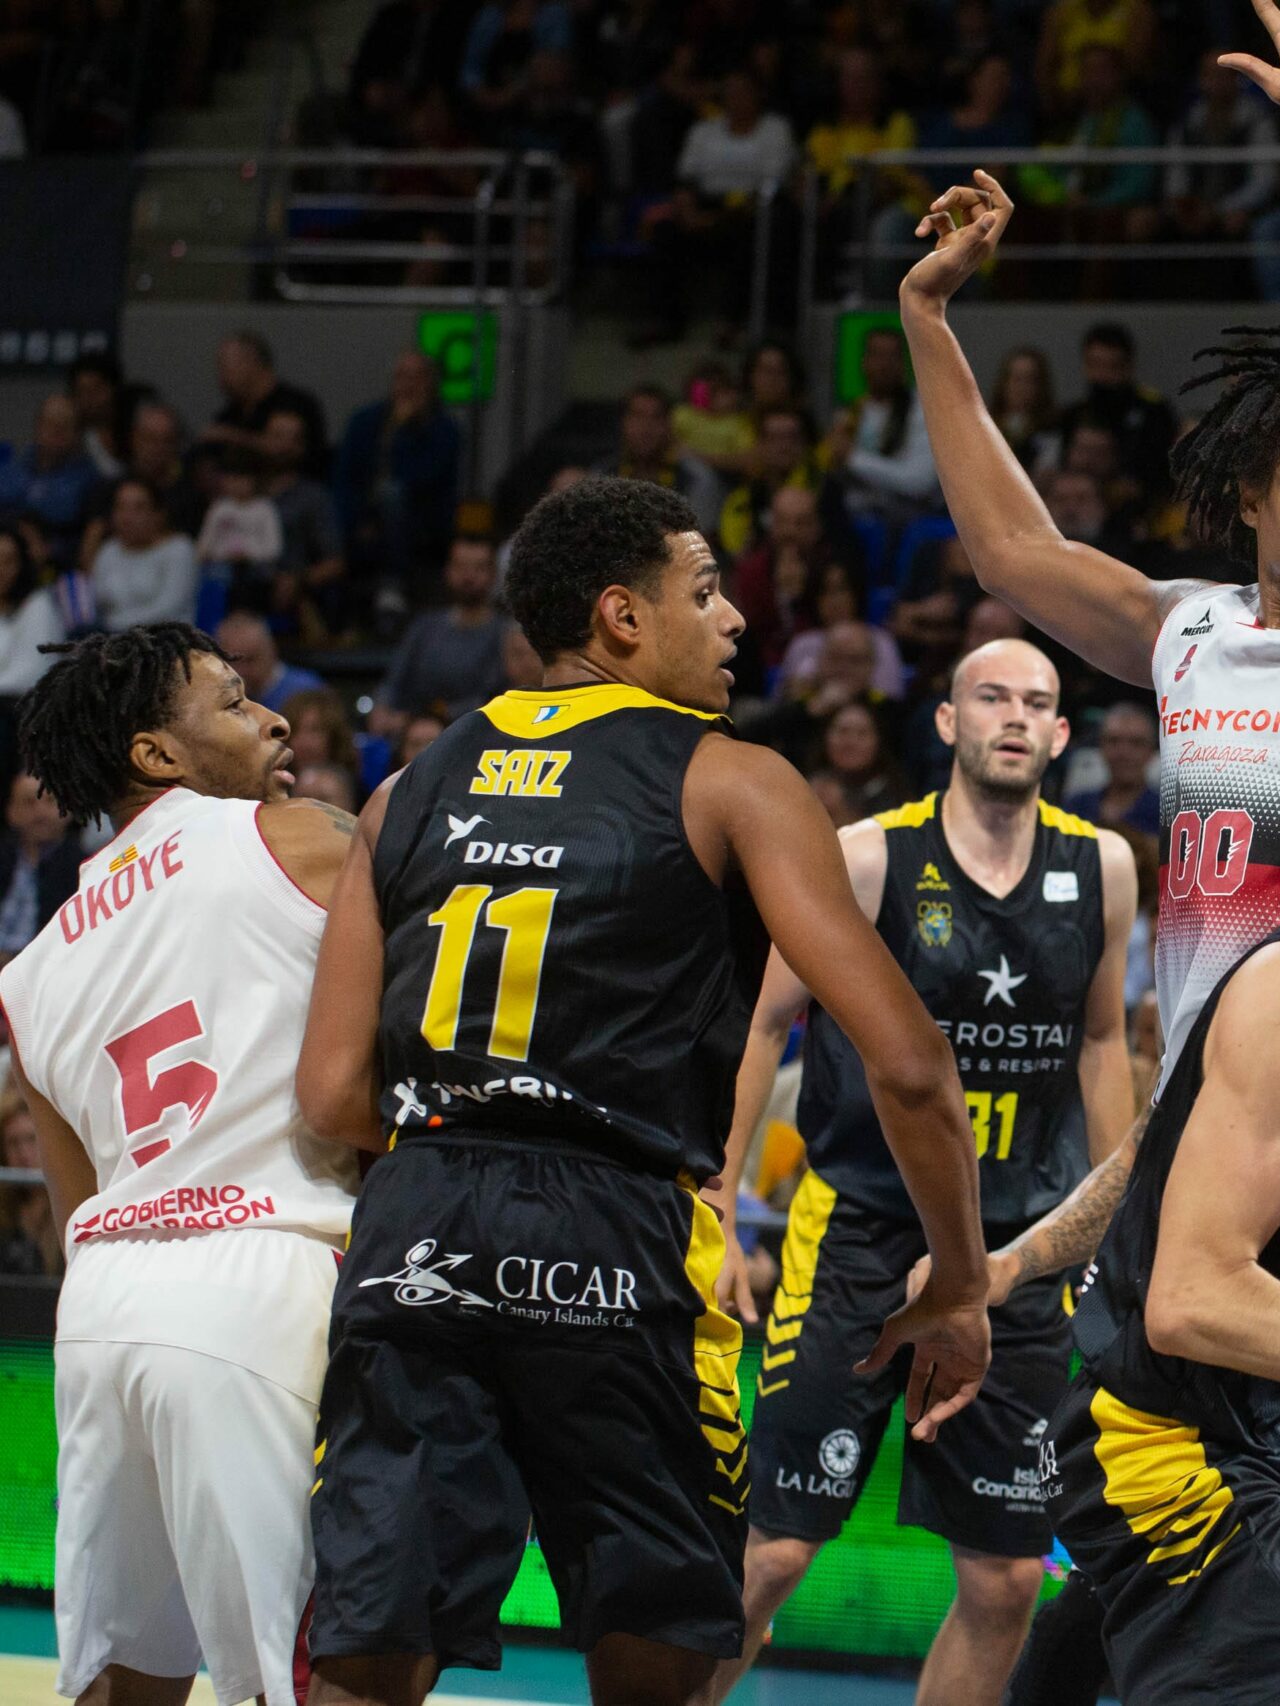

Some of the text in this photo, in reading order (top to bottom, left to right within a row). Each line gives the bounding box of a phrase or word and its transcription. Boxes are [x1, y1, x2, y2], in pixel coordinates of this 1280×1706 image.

[469, 749, 572, 798] SAIZ
[1178, 741, 1269, 772] Zaragoza
[1167, 808, 1255, 899] 00
[59, 829, 184, 944] OKOYE
[420, 883, 560, 1063] 11
[103, 997, 219, 1170] 5
[103, 1184, 245, 1233] GOBIERNO
[496, 1256, 640, 1311] CICAR
[496, 1301, 551, 1325] Canary
[554, 1307, 609, 1328] Islands
[776, 1467, 803, 1492] LA
